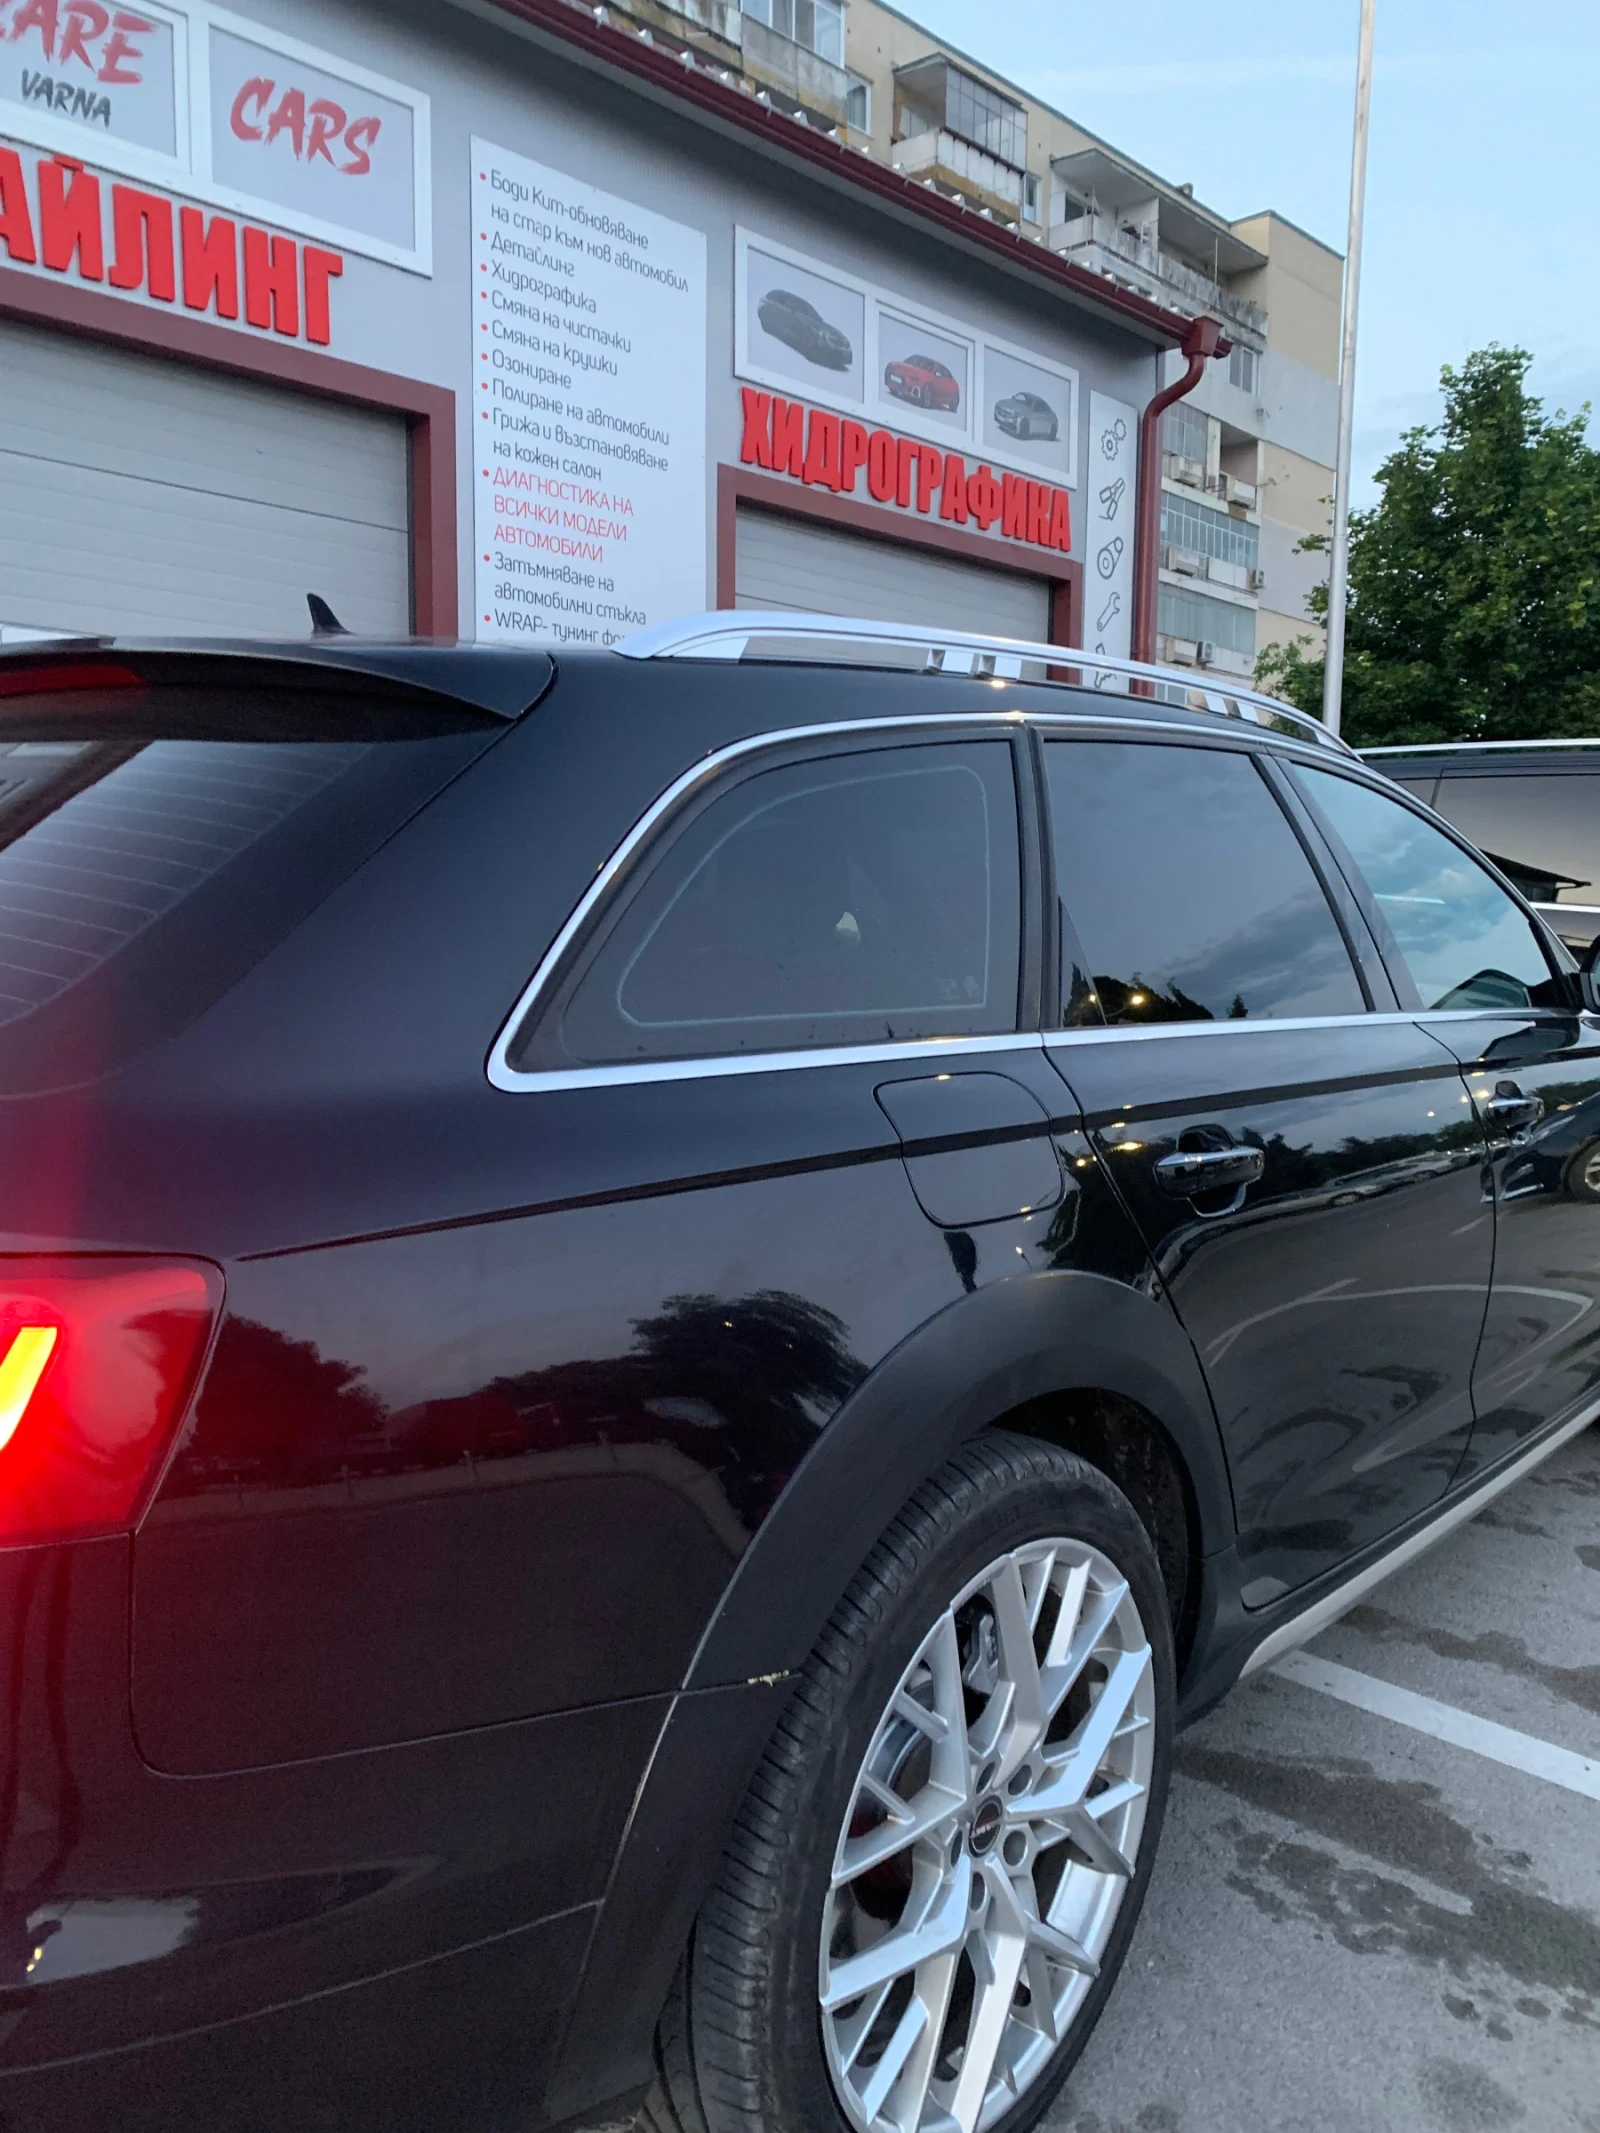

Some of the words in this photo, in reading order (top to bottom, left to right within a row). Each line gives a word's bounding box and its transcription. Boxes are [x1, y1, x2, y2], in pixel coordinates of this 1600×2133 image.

[0, 0, 157, 84] ARE
[21, 68, 111, 129] VARNA
[230, 76, 381, 175] CARS
[491, 169, 529, 201] Боди
[532, 186, 648, 249] Кит-обновяване
[491, 204, 509, 223] на
[513, 212, 551, 242] стар
[555, 225, 583, 252] към
[587, 241, 611, 263] нов
[614, 252, 689, 292] автомобил
[491, 231, 575, 277] Детайлинг
[491, 259, 597, 313] Хидрографика
[492, 290, 540, 322] Смяна
[543, 311, 560, 329] на
[563, 318, 631, 353] чистачки
[492, 319, 540, 351] Смяна
[543, 341, 560, 357] на
[564, 343, 618, 376] крушки
[492, 349, 572, 389] Озониране
[493, 378, 563, 415] Полиране
[566, 404, 583, 421] на
[586, 408, 669, 446] автомобили
[493, 407, 540, 438] Грижа
[543, 425, 551, 440] и
[555, 425, 669, 472] възстановяване
[493, 441, 511, 458] на
[515, 442, 559, 470] кожен
[562, 459, 602, 481] салон
[741, 387, 1071, 552] ХИДРОГРАФИКА
[493, 466, 610, 510] ДИАГНОСТИКА
[613, 495, 634, 516] НА
[494, 495, 559, 526] ВСИЧКИ
[563, 511, 627, 541] МОДЕЛИ
[494, 524, 603, 563] АВТОМОБИЛИ
[494, 552, 595, 589] Затъмняване
[598, 573, 614, 592] на
[494, 582, 593, 615] автомобилни
[596, 604, 646, 625] стъкла
[552, 623, 599, 642] тунинг
